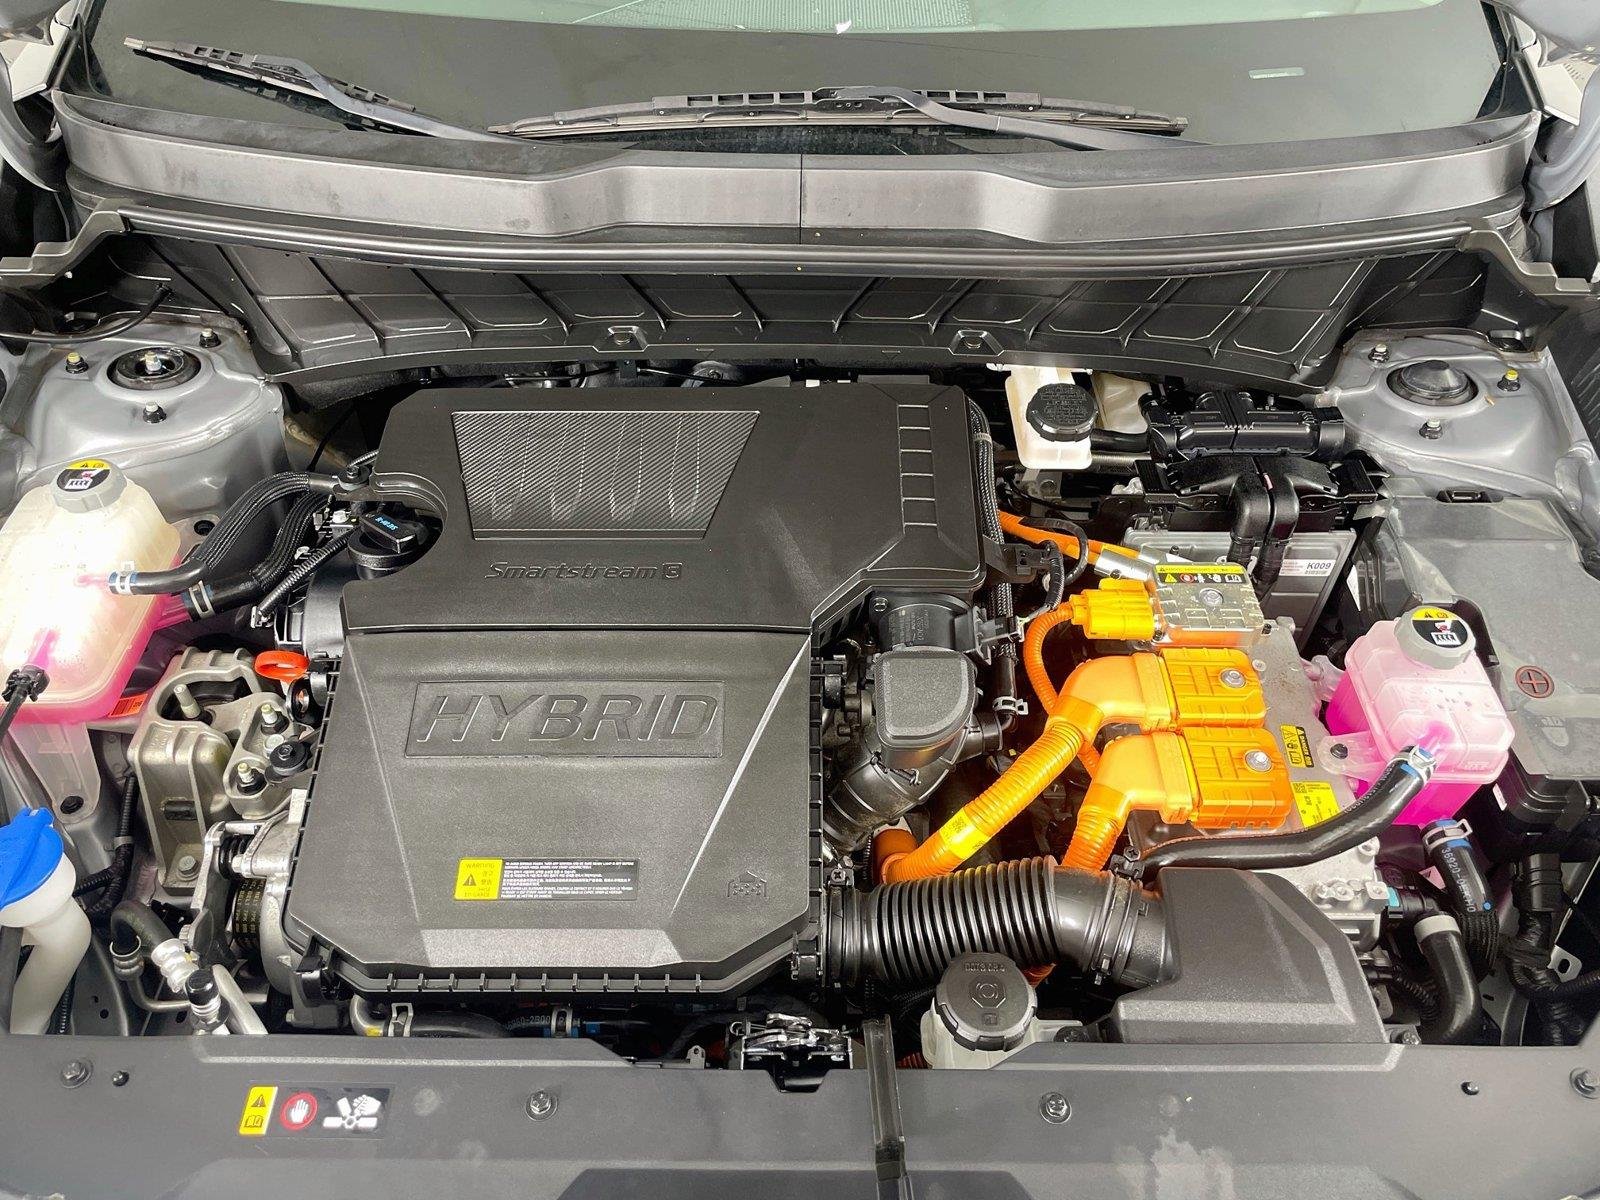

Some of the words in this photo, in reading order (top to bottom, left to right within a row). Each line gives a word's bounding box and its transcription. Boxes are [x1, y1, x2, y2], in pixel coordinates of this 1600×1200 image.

[484, 561, 658, 579] Smartstream
[1306, 562, 1332, 570] K009
[416, 694, 718, 742] HYBRID
